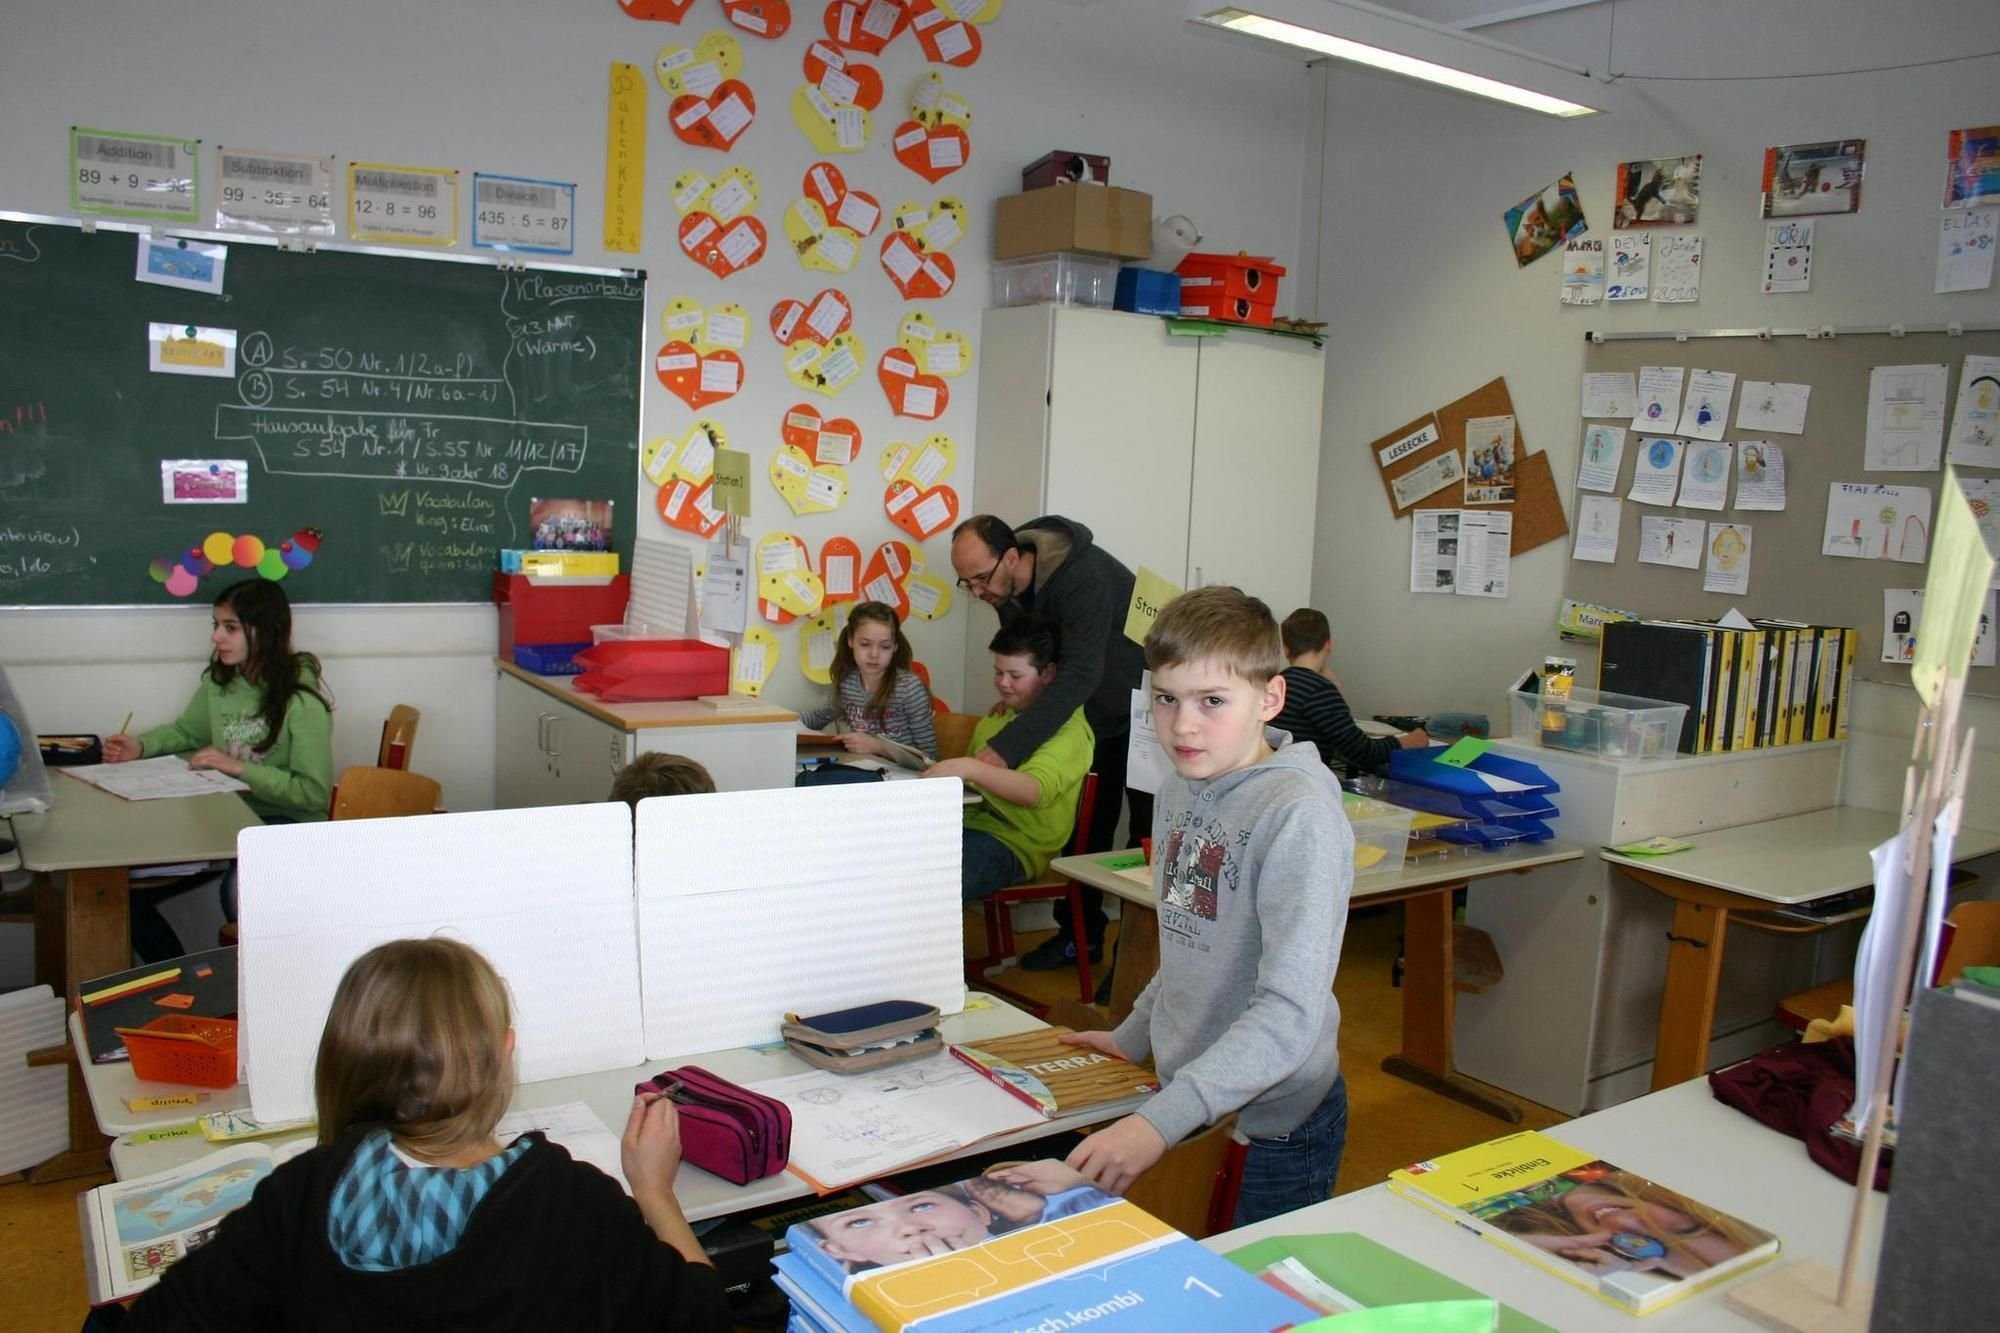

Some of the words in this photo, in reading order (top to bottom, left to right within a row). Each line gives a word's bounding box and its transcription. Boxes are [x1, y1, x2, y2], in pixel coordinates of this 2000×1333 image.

[97, 143, 152, 160] Addition
[79, 168, 101, 184] 89
[110, 174, 120, 184] +
[128, 174, 139, 188] 9
[223, 187, 244, 202] 99
[264, 190, 285, 206] 35
[308, 194, 328, 208] 64
[495, 188, 538, 202] Division
[355, 199, 373, 214] 12
[386, 202, 395, 215] 8
[402, 206, 411, 214] =
[418, 205, 436, 219] 96
[478, 211, 505, 225] 435
[522, 214, 530, 228] 5
[536, 218, 545, 226] =
[551, 217, 568, 231] 87
[319, 347, 352, 370] 50
[319, 378, 349, 398] 54
[252, 414, 378, 442] Hausaufgabe
[1388, 432, 1429, 460] LESEECKE
[487, 462, 510, 480] 18
[1135, 596, 1159, 619] Stat
[1578, 613, 1603, 627] Marc
[1187, 868, 1213, 892] Trail
[1024, 1052, 1111, 1074] TERRA
[1491, 1158, 1550, 1181] Einblicke
[1182, 1275, 1224, 1300] 1
